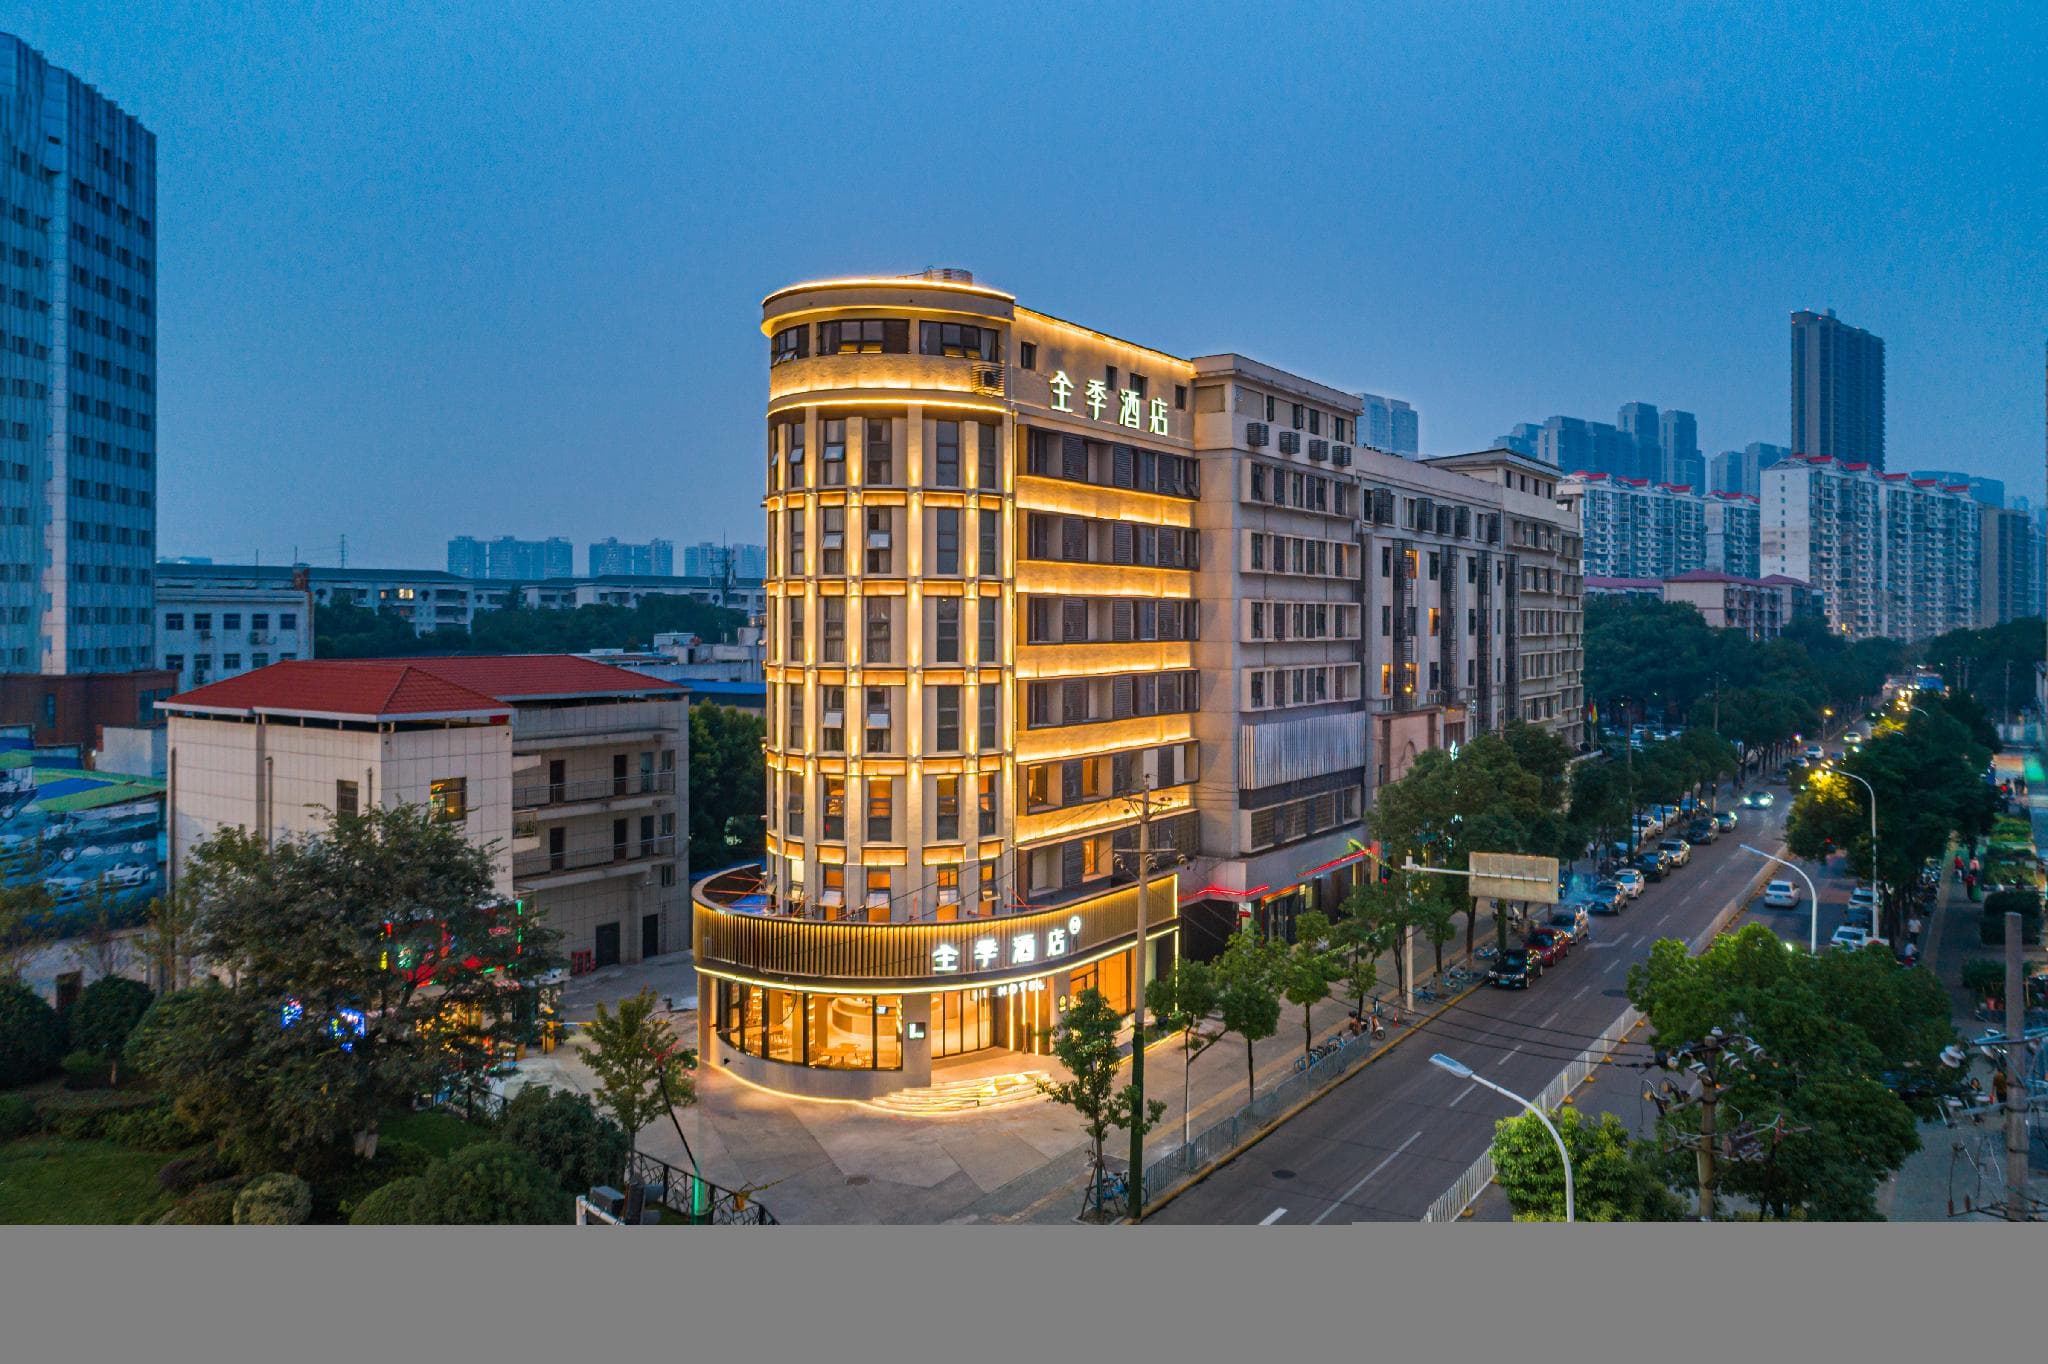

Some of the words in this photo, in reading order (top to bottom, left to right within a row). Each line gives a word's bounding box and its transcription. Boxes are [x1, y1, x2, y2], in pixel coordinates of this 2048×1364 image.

[1049, 370, 1168, 436] 全季酒店
[932, 928, 1065, 971] 全季酒店
